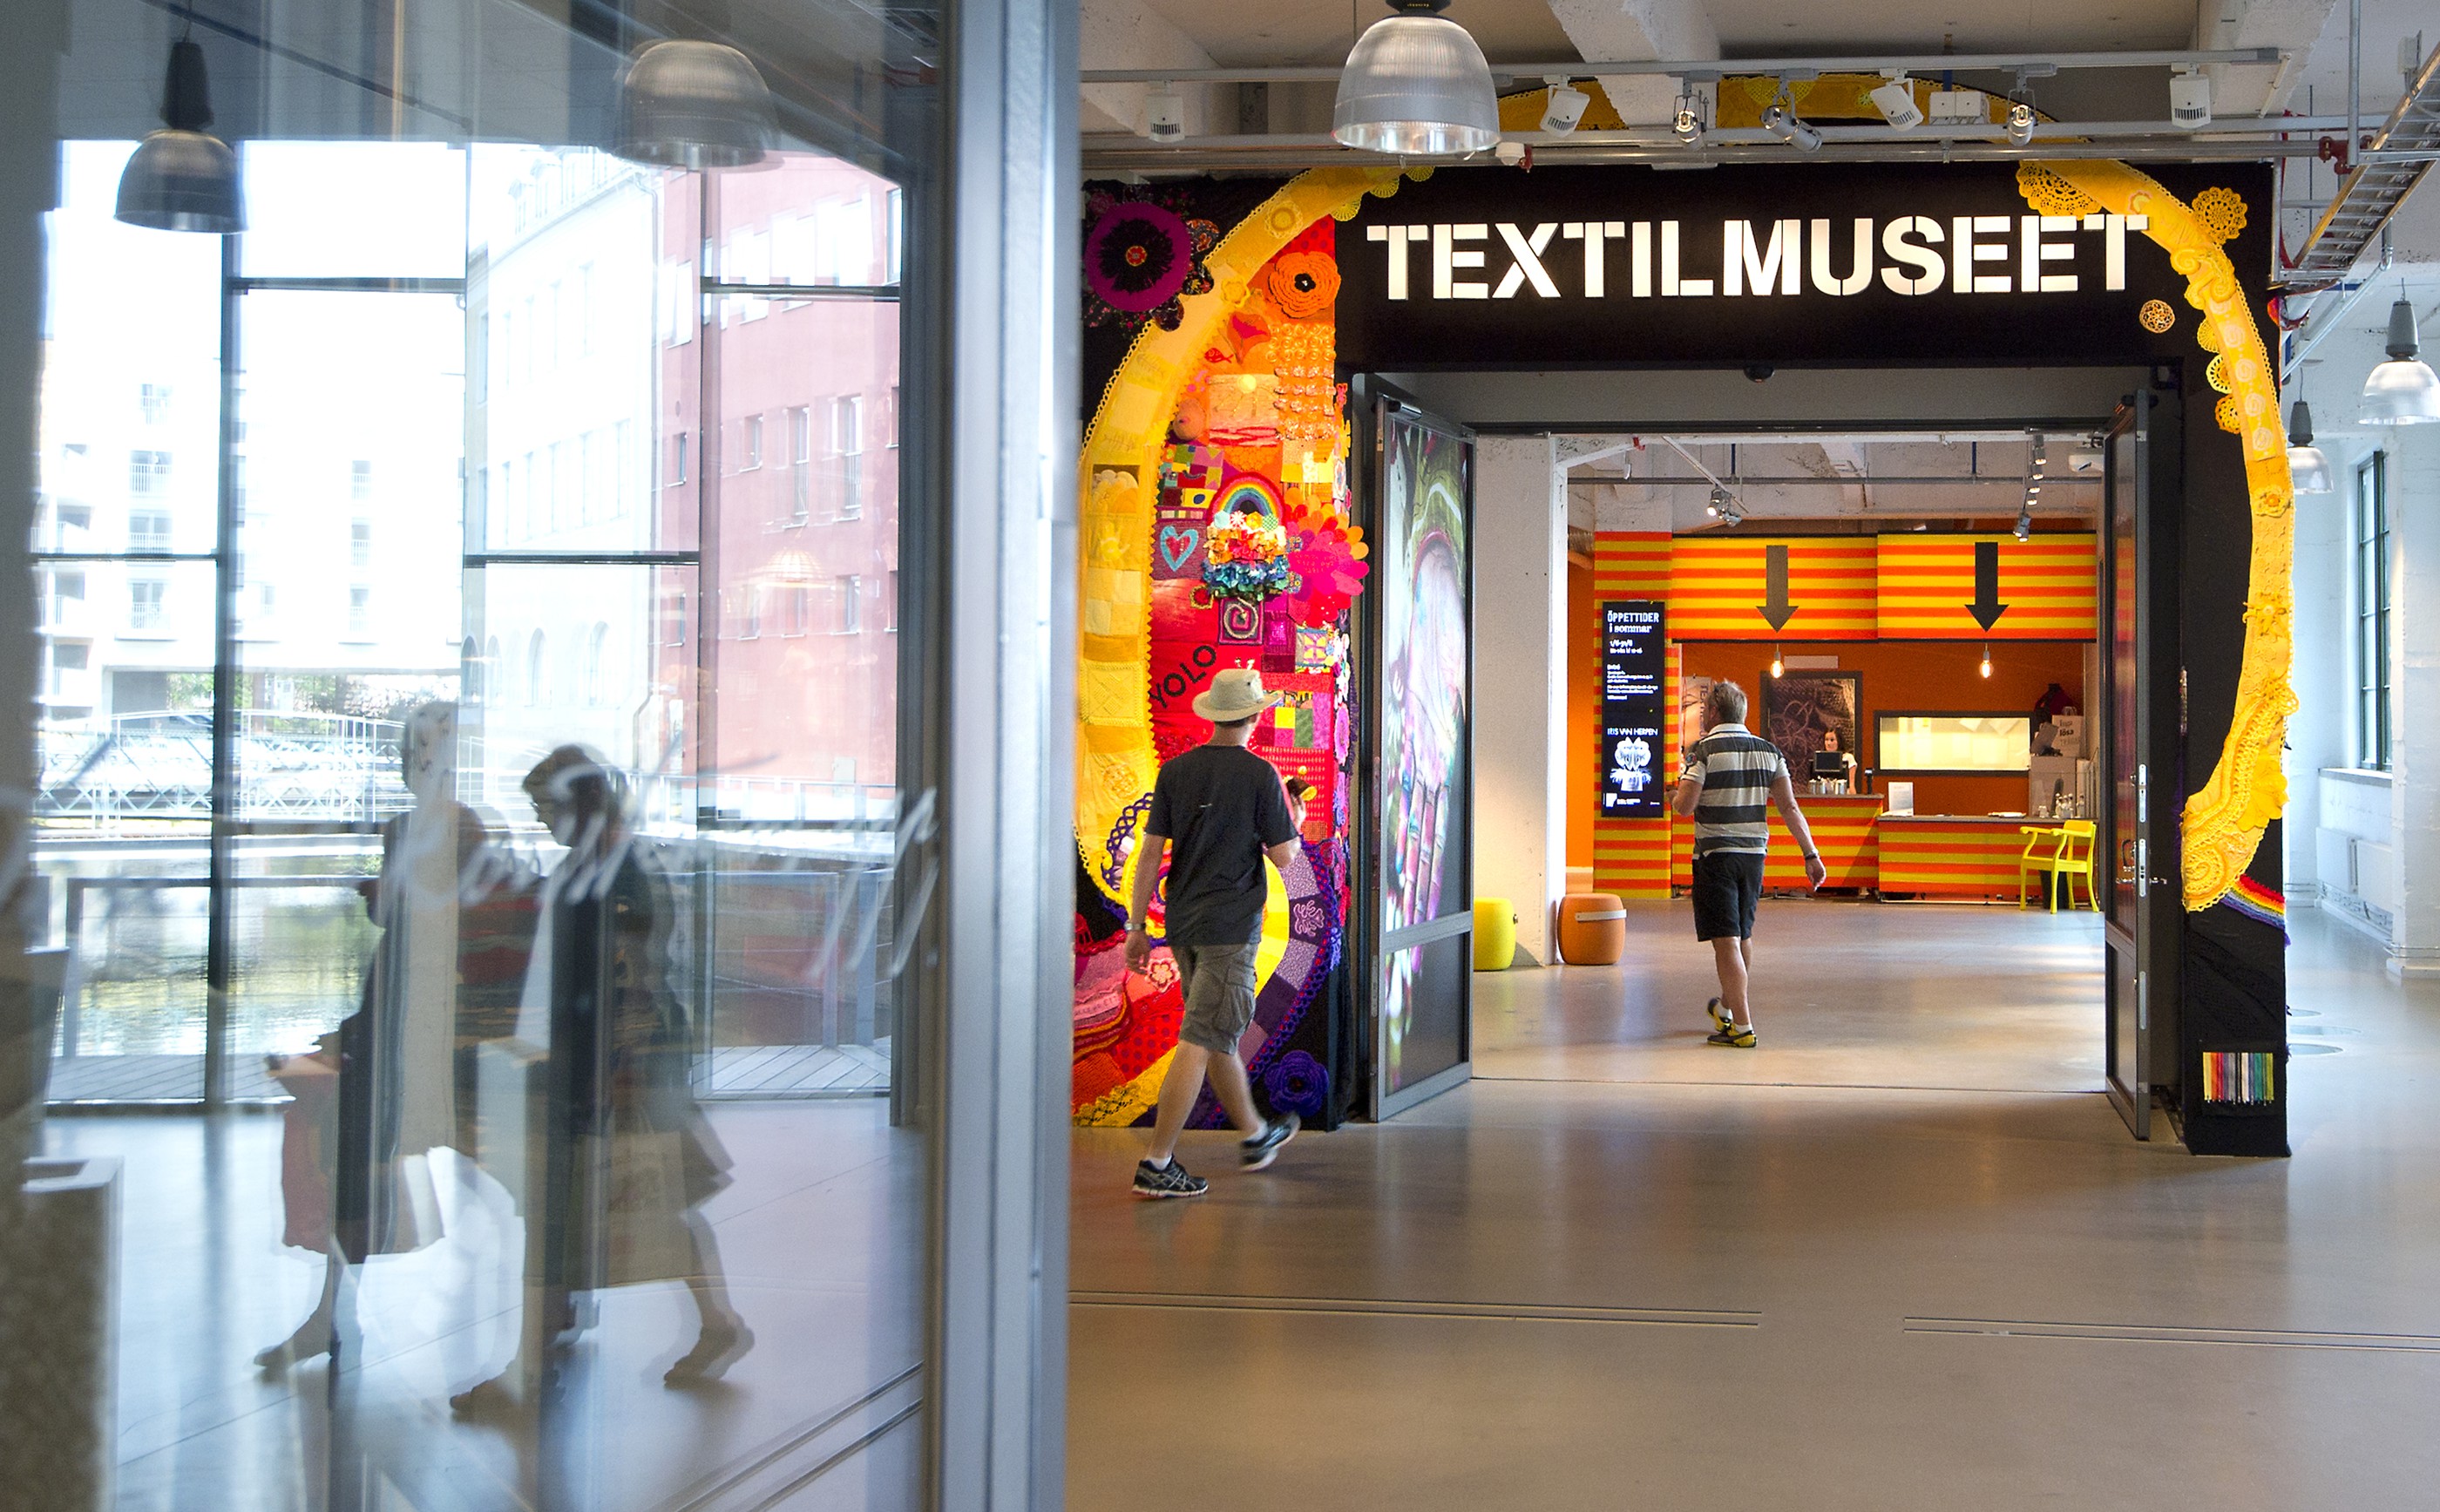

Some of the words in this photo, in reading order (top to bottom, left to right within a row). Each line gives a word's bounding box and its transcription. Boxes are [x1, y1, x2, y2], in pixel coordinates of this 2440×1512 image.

[1366, 214, 2150, 302] TEXTILMUSEET
[1607, 610, 1660, 623] ÖPPETTIDER
[1609, 622, 1613, 634] i
[1614, 625, 1652, 634] sommar
[1148, 645, 1217, 709] YOLO
[1619, 727, 1633, 736] VAN
